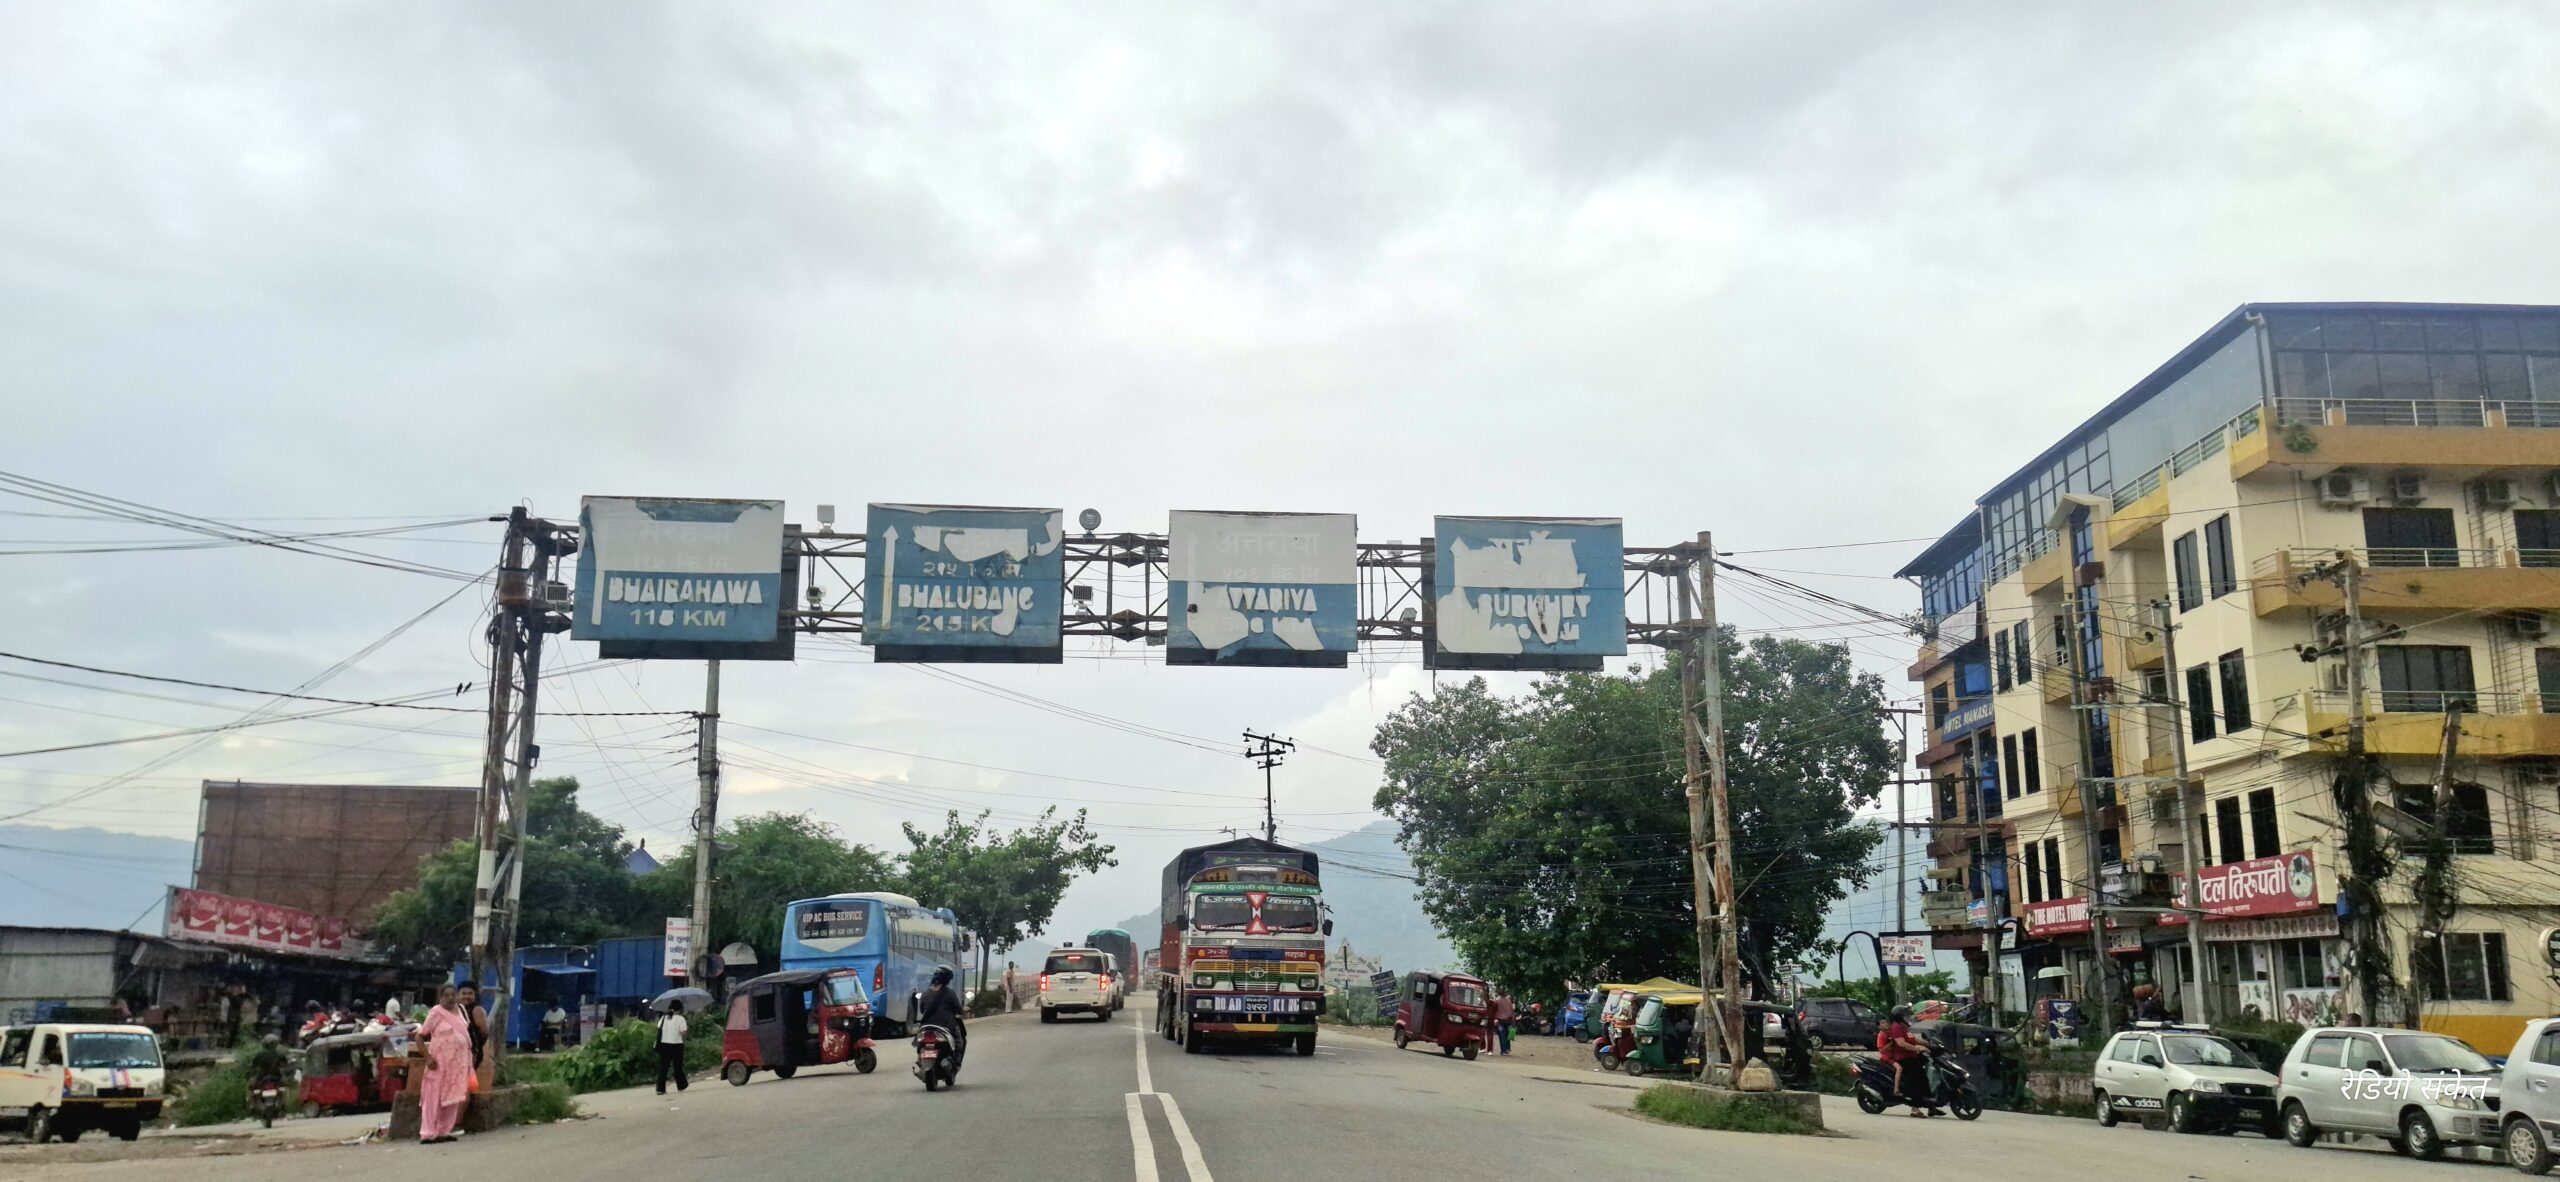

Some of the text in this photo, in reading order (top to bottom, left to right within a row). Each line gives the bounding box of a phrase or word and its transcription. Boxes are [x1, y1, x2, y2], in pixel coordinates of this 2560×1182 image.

[608, 577, 762, 604] BHAIRAHAWA
[682, 610, 726, 627] KM
[823, 911, 836, 922] BUS
[837, 911, 863, 921] SERVICE
[2135, 1097, 2162, 1108] adidas
